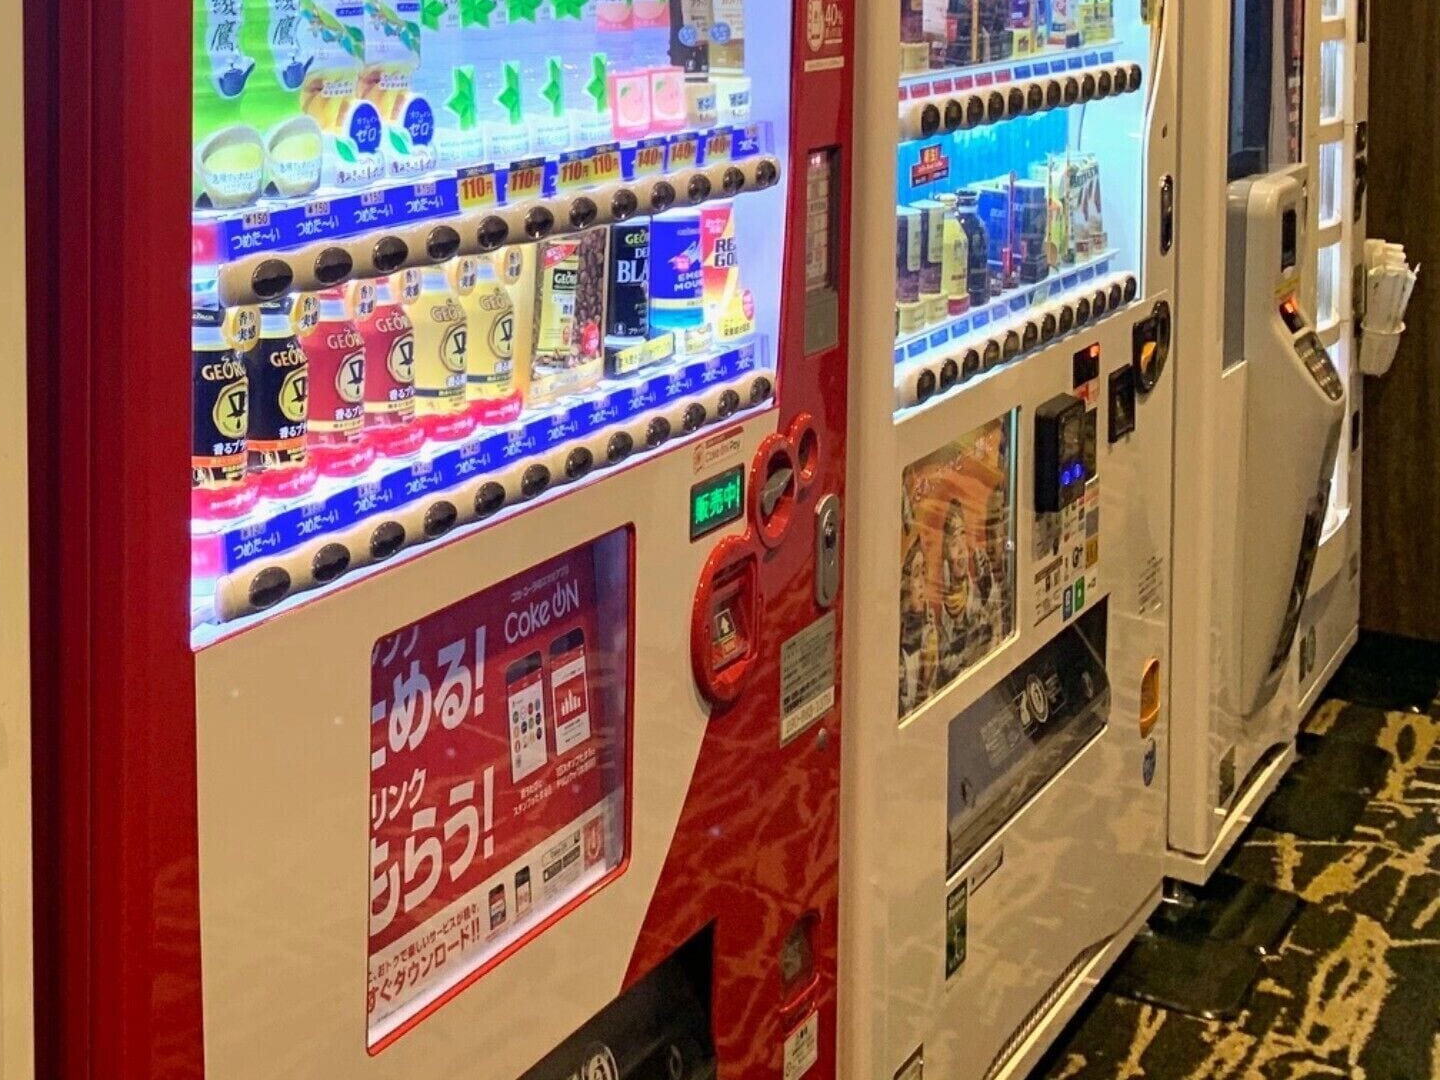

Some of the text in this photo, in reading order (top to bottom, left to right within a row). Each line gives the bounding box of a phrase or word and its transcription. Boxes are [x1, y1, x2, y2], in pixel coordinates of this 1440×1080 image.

[355, 126, 377, 144] ゼロ
[409, 121, 429, 139] ゼロ
[296, 217, 340, 237] つめた～い
[231, 228, 281, 250] つめた～い
[695, 482, 737, 524] 販売中
[504, 579, 580, 644] Coke ON
